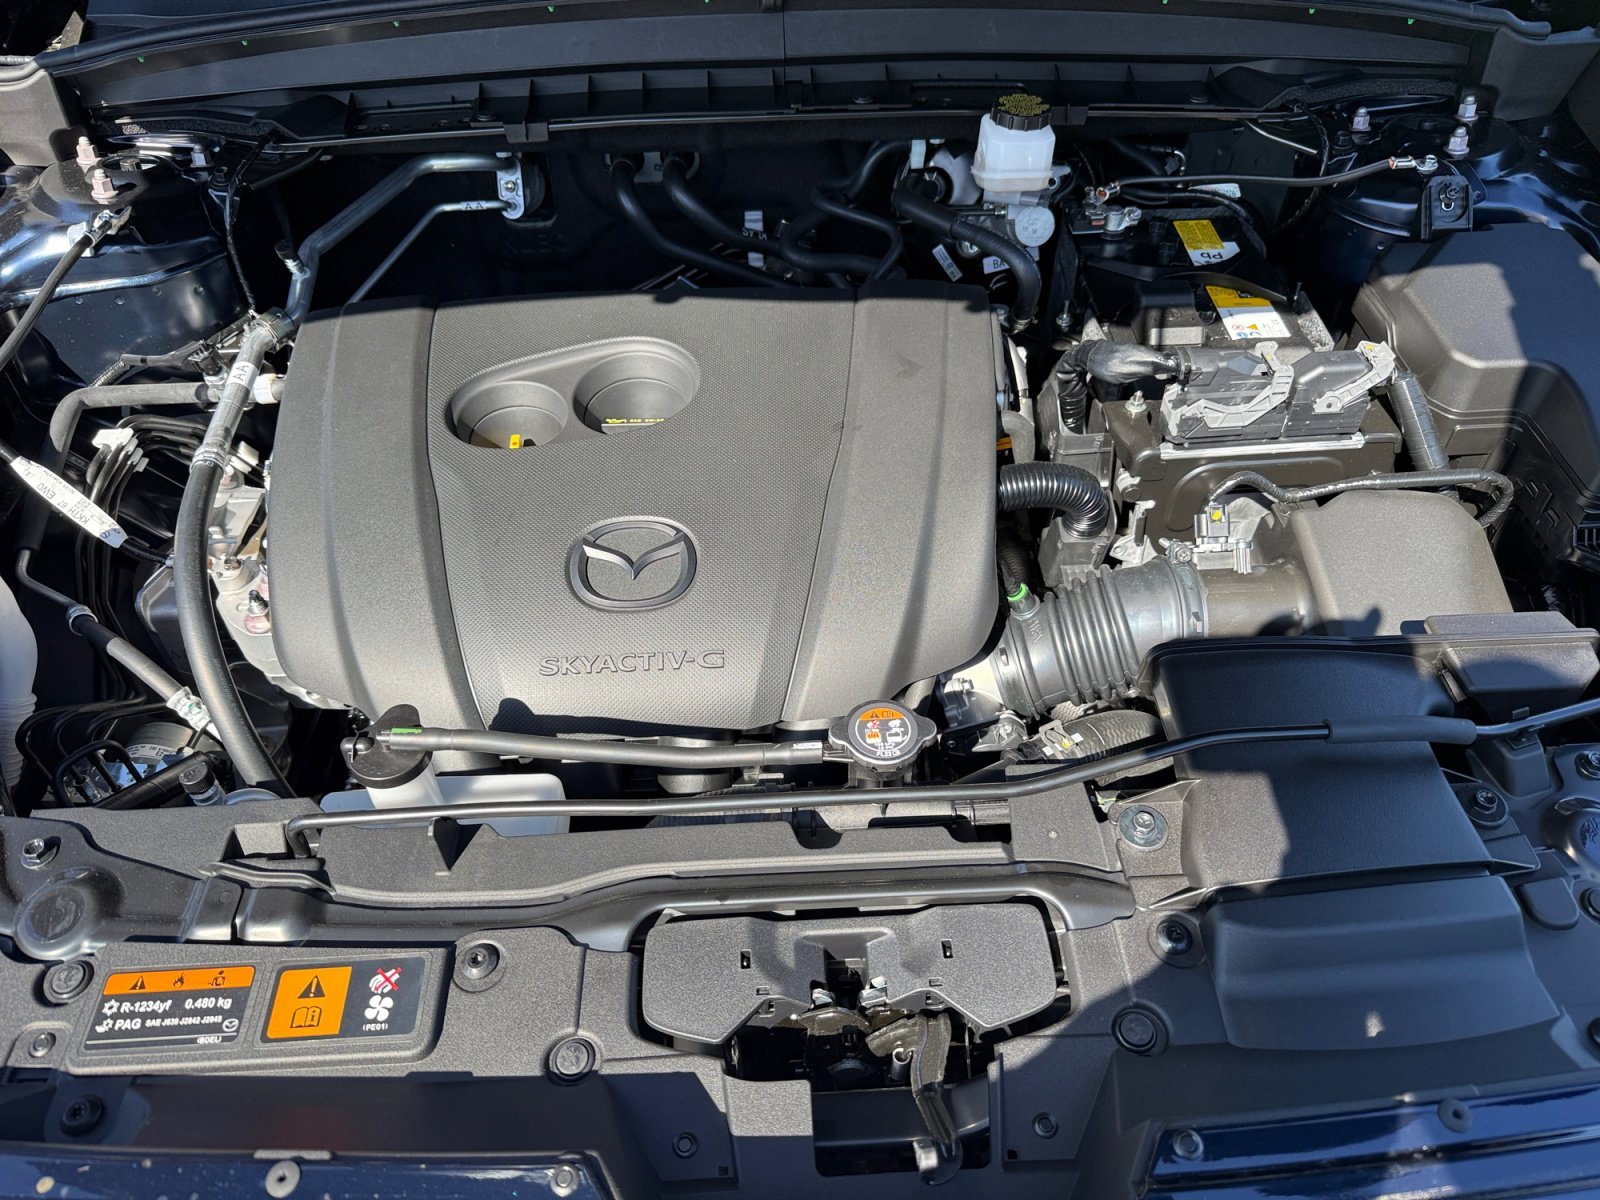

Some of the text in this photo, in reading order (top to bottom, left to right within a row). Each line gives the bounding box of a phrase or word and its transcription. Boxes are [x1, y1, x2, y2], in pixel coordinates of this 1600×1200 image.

[539, 650, 725, 676] SKYACTIV-G
[120, 996, 233, 1014] R-1234yf 0.480 kg
[114, 1018, 141, 1031] PAG
[145, 1018, 161, 1028] SAE
